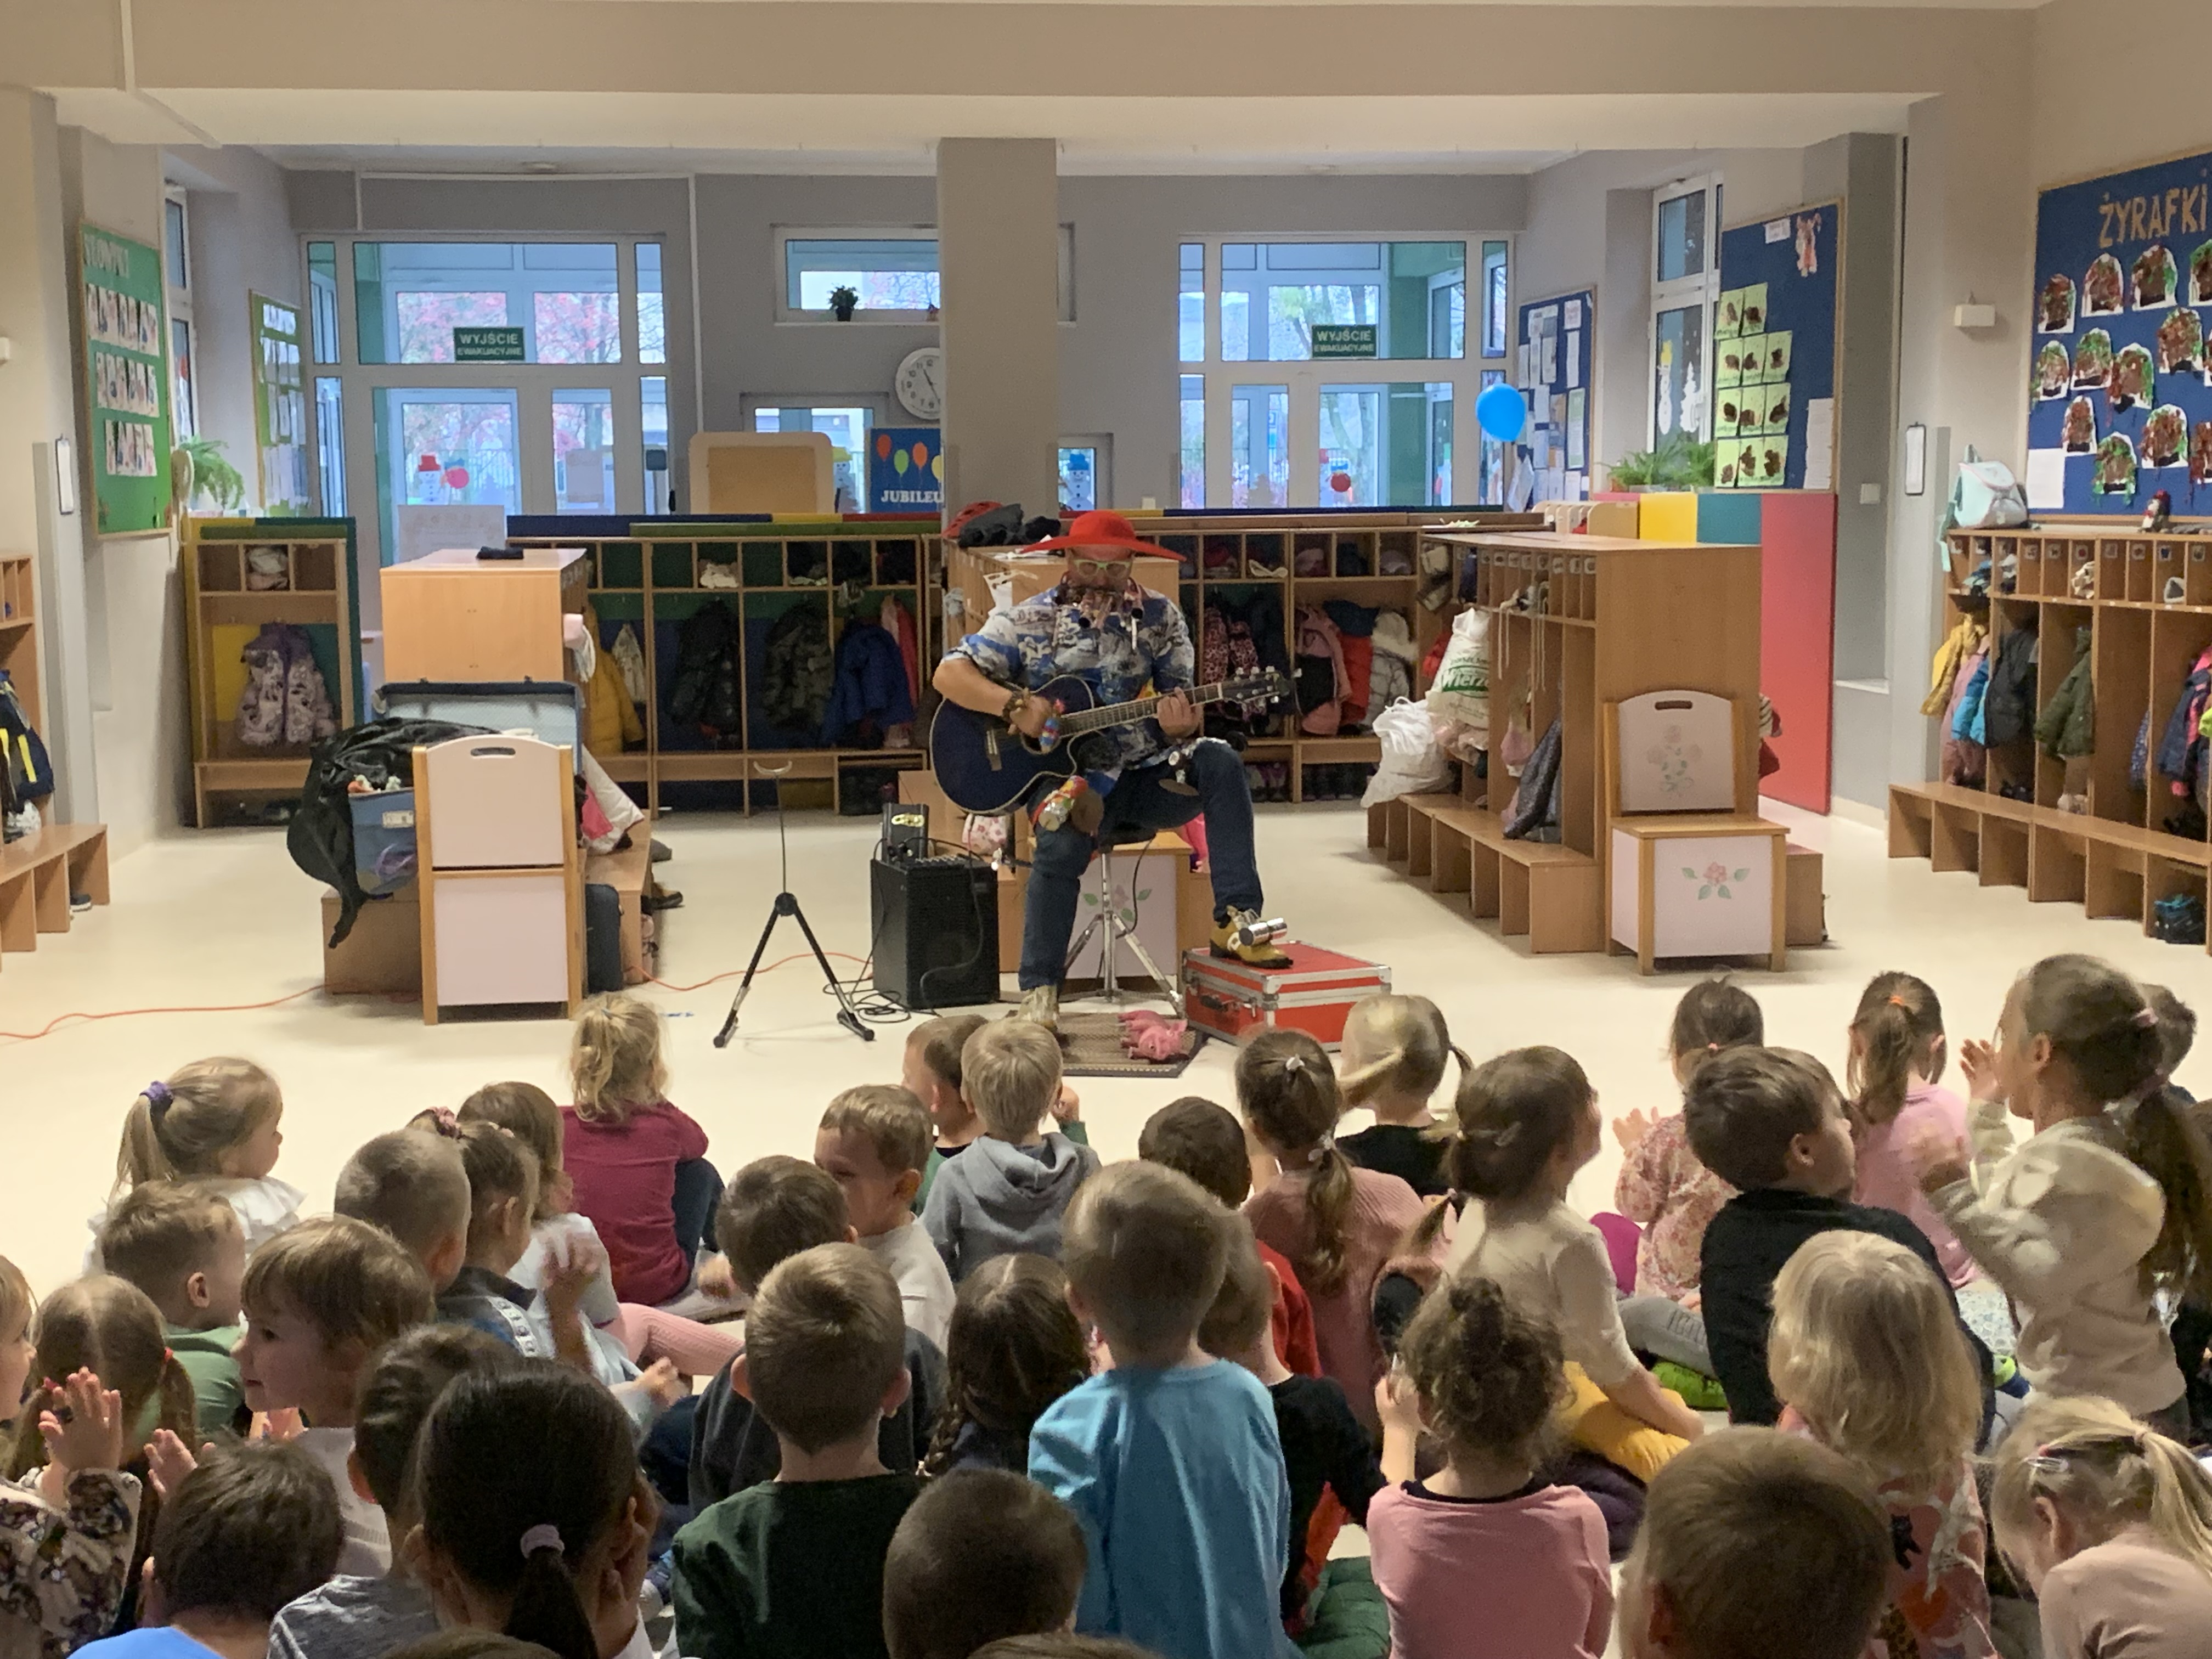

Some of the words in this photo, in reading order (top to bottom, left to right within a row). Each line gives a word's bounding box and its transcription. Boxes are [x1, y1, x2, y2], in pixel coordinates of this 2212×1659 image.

[2099, 168, 2208, 249] ŻYRAFKI
[459, 331, 518, 345] WYJŚCIE
[1317, 328, 1371, 341] WYJŚCIE
